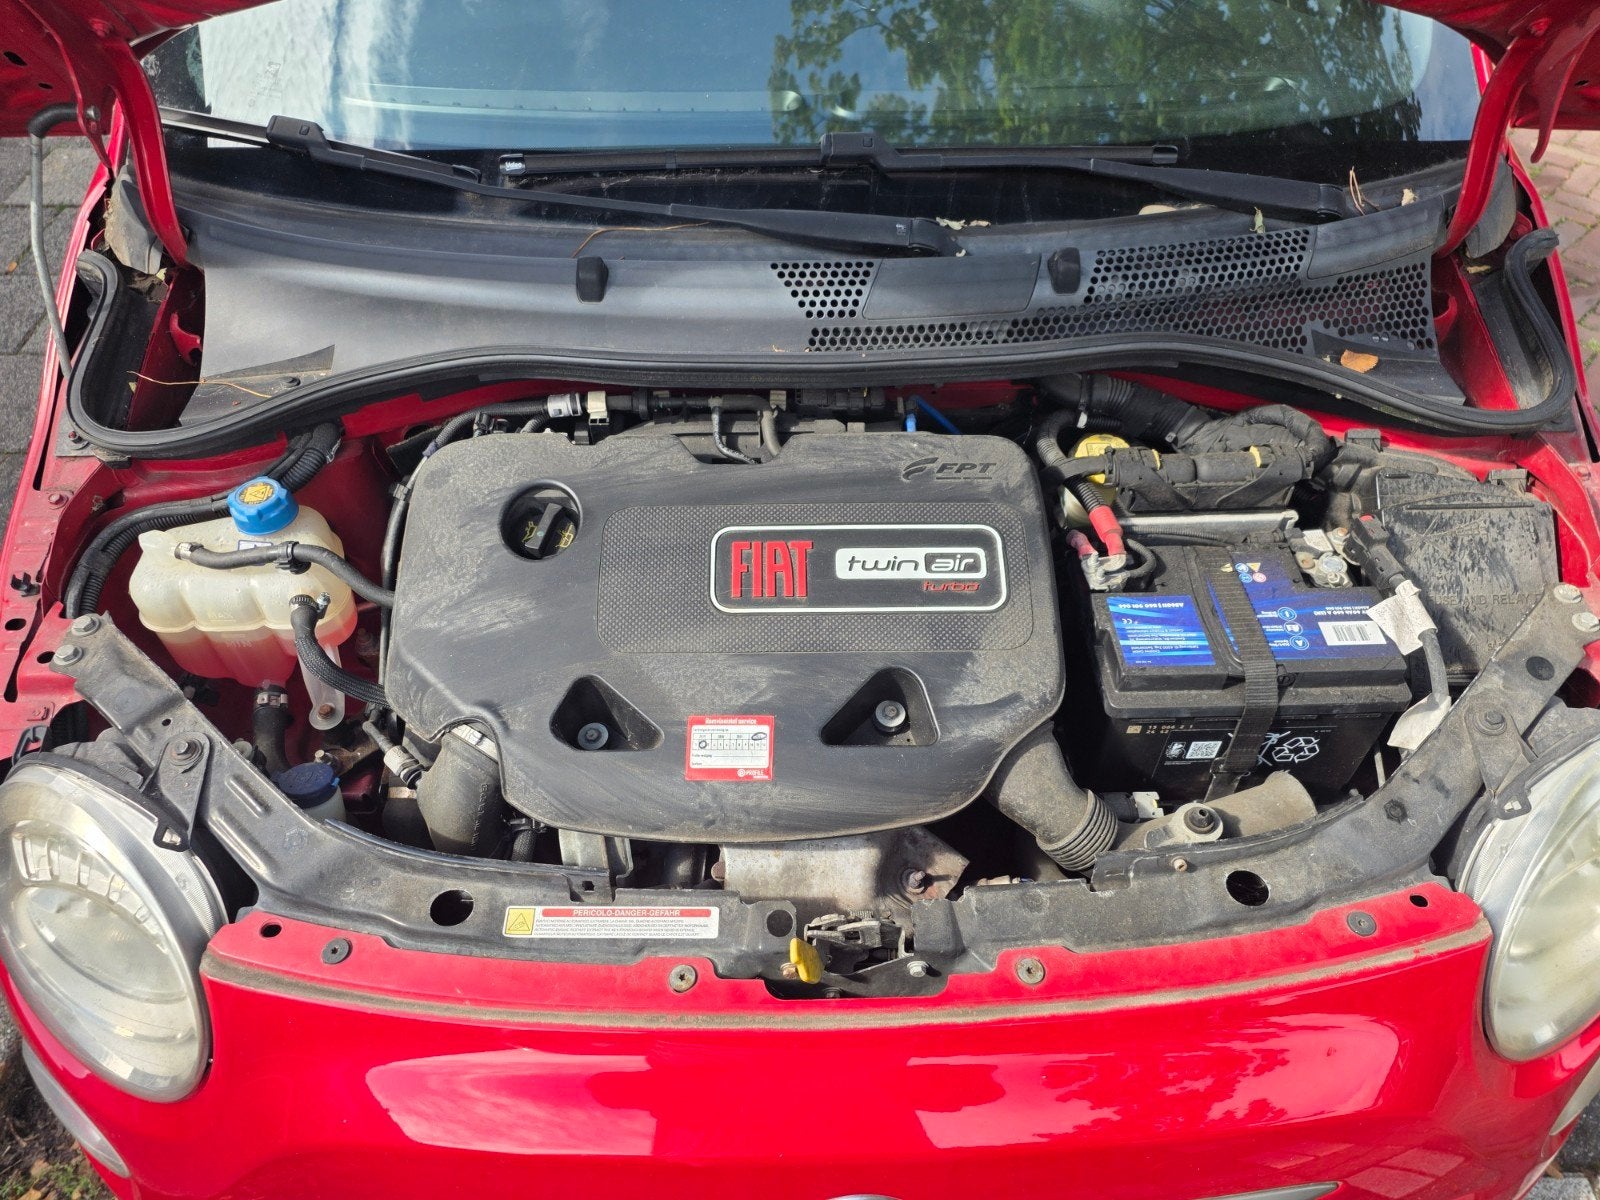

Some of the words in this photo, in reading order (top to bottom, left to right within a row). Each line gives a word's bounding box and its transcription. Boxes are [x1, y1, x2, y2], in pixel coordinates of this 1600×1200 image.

[936, 463, 997, 473] FPT
[731, 541, 814, 598] FIAT
[848, 555, 920, 572] twin
[930, 554, 975, 572] air
[922, 581, 980, 592] turbo
